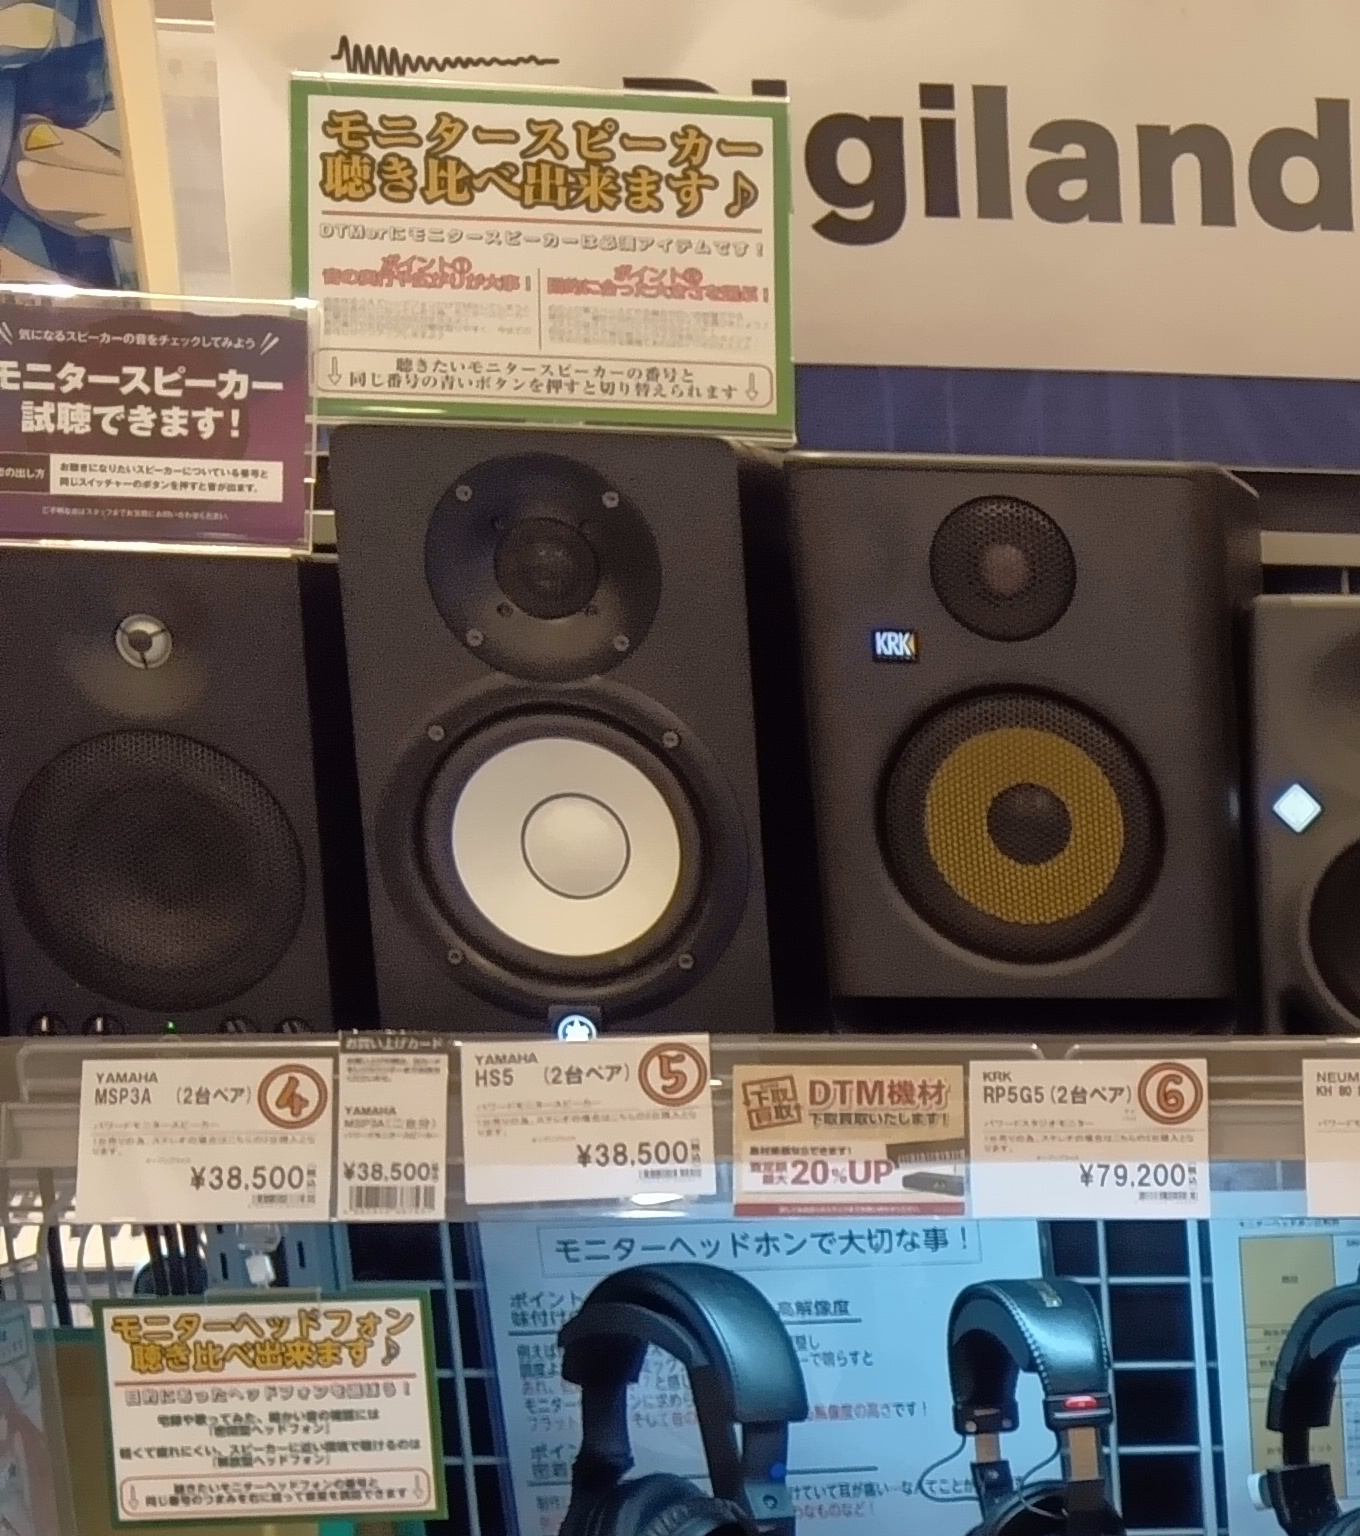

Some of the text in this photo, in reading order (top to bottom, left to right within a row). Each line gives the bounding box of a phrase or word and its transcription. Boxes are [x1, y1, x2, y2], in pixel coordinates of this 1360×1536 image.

[321, 109, 764, 168] モニタースピーカー
[19, 329, 256, 349] 気になるスピーカーの音をチェックしてみよう
[0, 361, 284, 400] モニタースピーカー
[396, 357, 695, 384] 聴きたいモニタースピーカーの番号と
[875, 631, 911, 656] KRK
[474, 1051, 539, 1065] YAMAHA
[96, 1071, 159, 1084] YAMAHA
[474, 1069, 515, 1087] HS5
[982, 1071, 1013, 1082] KRK
[94, 1087, 152, 1106] MSP3A
[808, 1078, 947, 1107] DTM機材
[1316, 1085, 1333, 1097] KH
[344, 1105, 397, 1116] YAMAHA
[576, 1140, 689, 1168] ¥38,500
[190, 1164, 305, 1191] ¥38,500
[343, 1162, 430, 1182] ¥38,500
[1080, 1163, 1186, 1188] ¥79,200
[111, 1308, 415, 1343] モニターヘッドフォン
